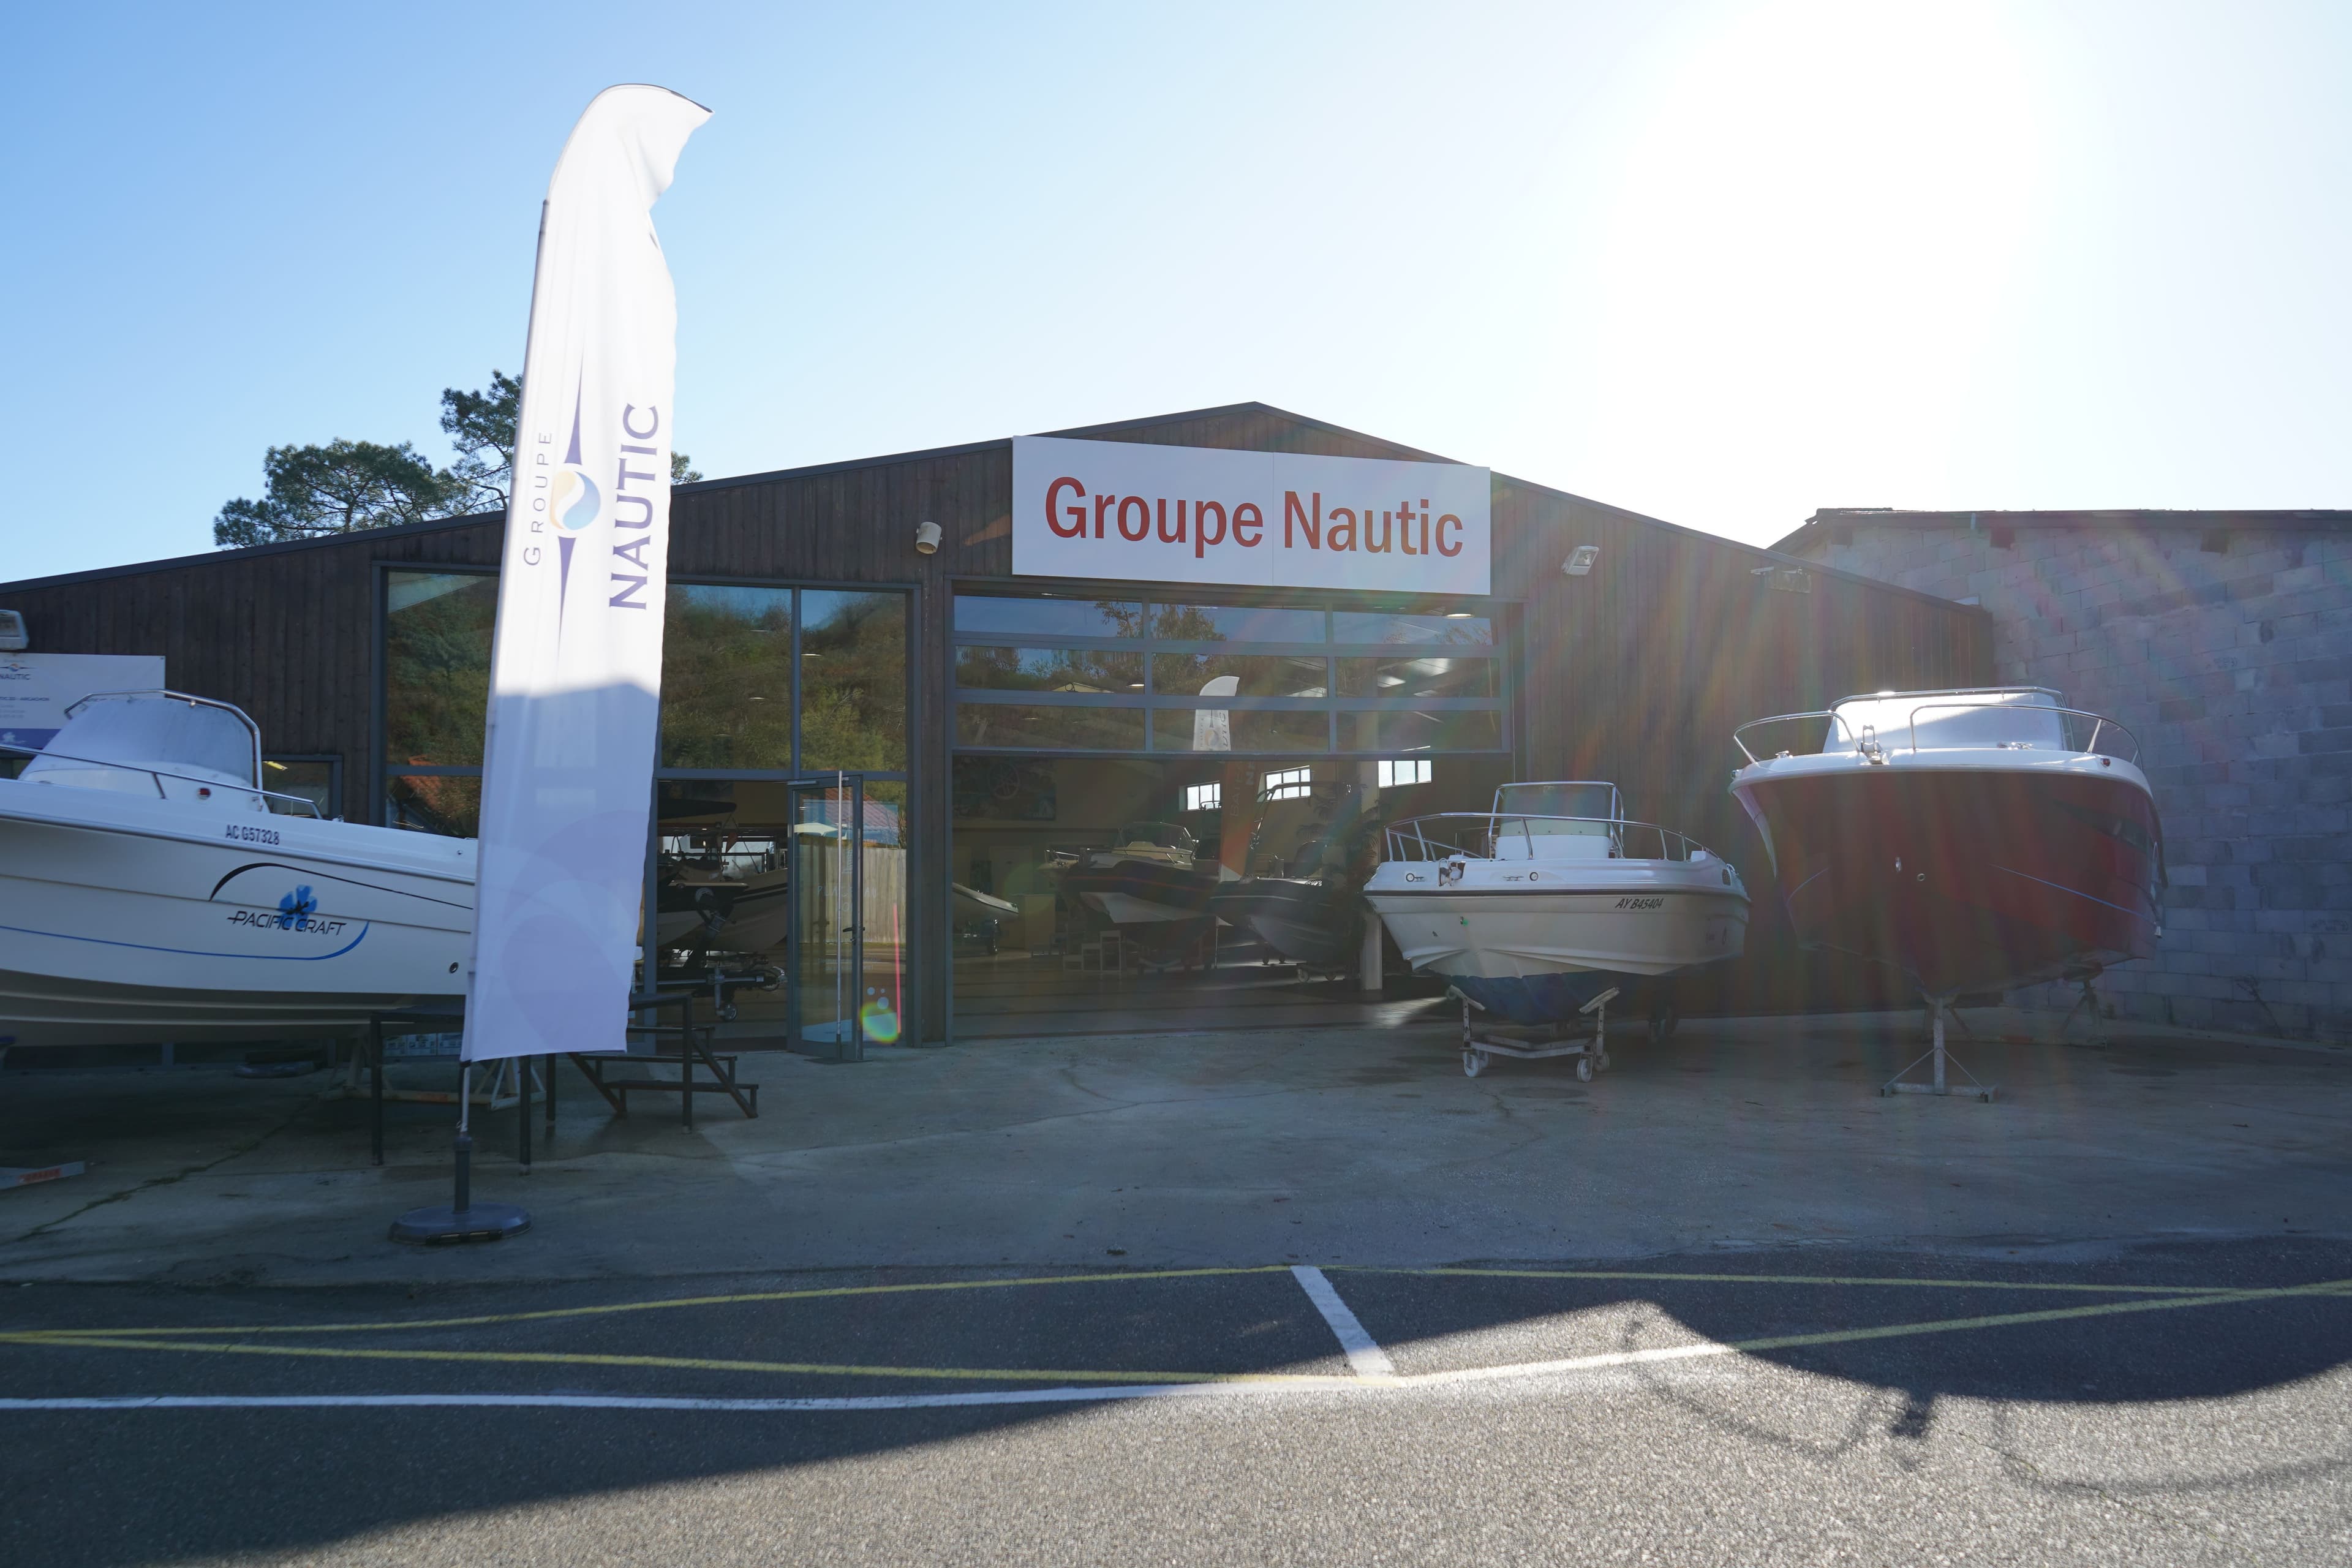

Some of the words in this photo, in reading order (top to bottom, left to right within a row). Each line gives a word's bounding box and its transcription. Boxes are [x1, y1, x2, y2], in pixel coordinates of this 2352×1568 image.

[523, 432, 552, 566] GROUPE
[609, 403, 659, 610] NAUTIC
[1045, 477, 1264, 559] Groupe
[1284, 491, 1464, 558] Nautic
[225, 824, 239, 839] AC
[241, 827, 280, 845] G57328
[227, 911, 294, 931] PACIFIC
[295, 917, 347, 936] CRAFT
[1615, 898, 1632, 909] AY
[1630, 898, 1664, 910] B45404
